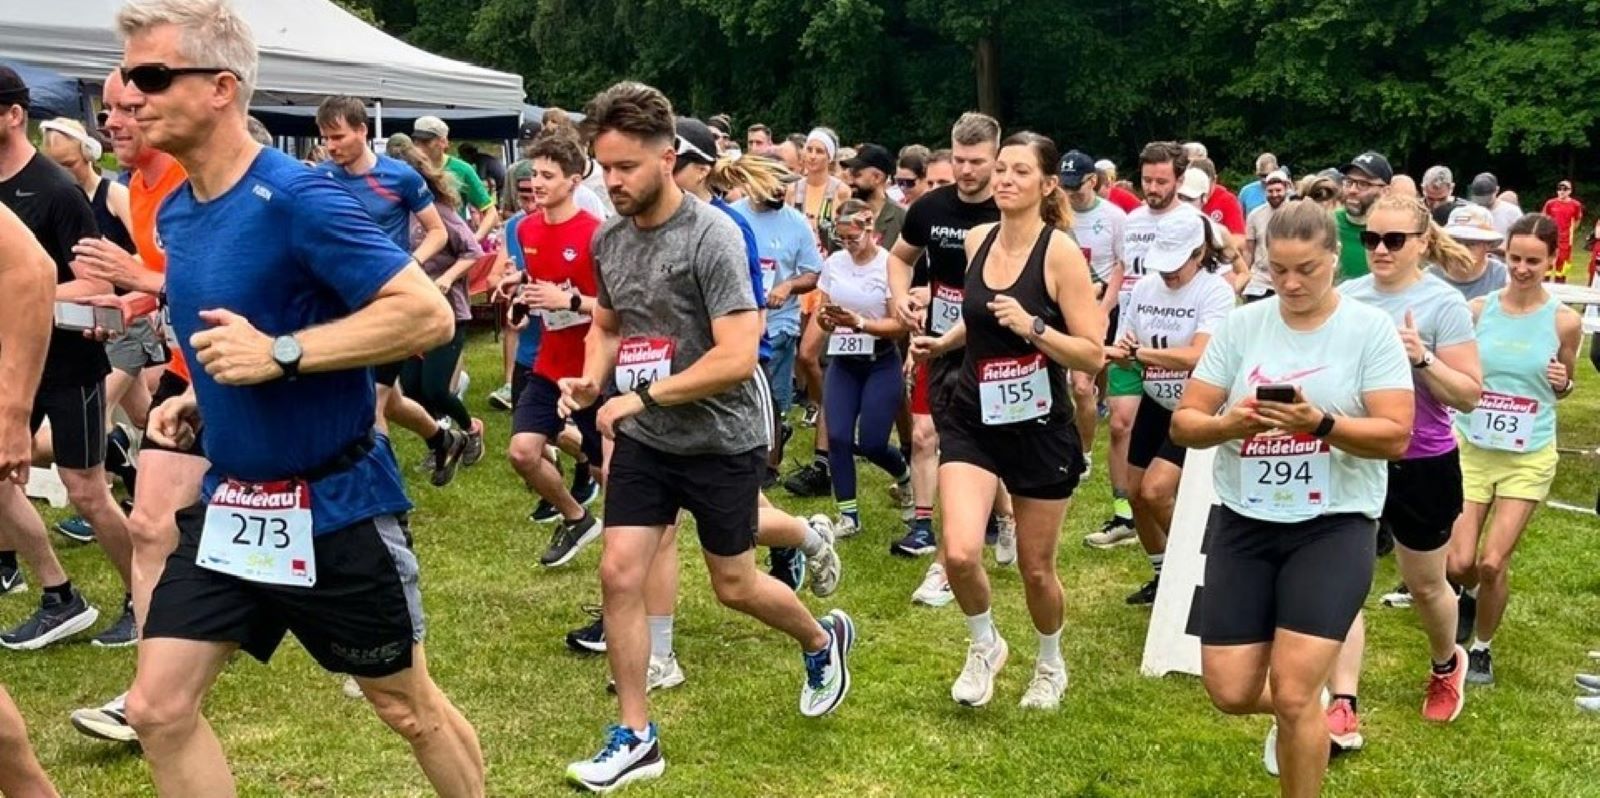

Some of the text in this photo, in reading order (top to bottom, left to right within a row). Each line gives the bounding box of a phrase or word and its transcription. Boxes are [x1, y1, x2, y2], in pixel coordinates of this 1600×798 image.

[942, 302, 959, 322] 29
[1136, 303, 1196, 319] KAMROC
[838, 337, 864, 352] 281
[983, 354, 1043, 381] Heidelauf
[997, 380, 1034, 405] 155
[1153, 382, 1183, 400] 238
[1485, 412, 1519, 434] 163
[1245, 438, 1322, 456] Heidelauf
[1257, 460, 1313, 486] 294
[230, 512, 291, 549] 273
